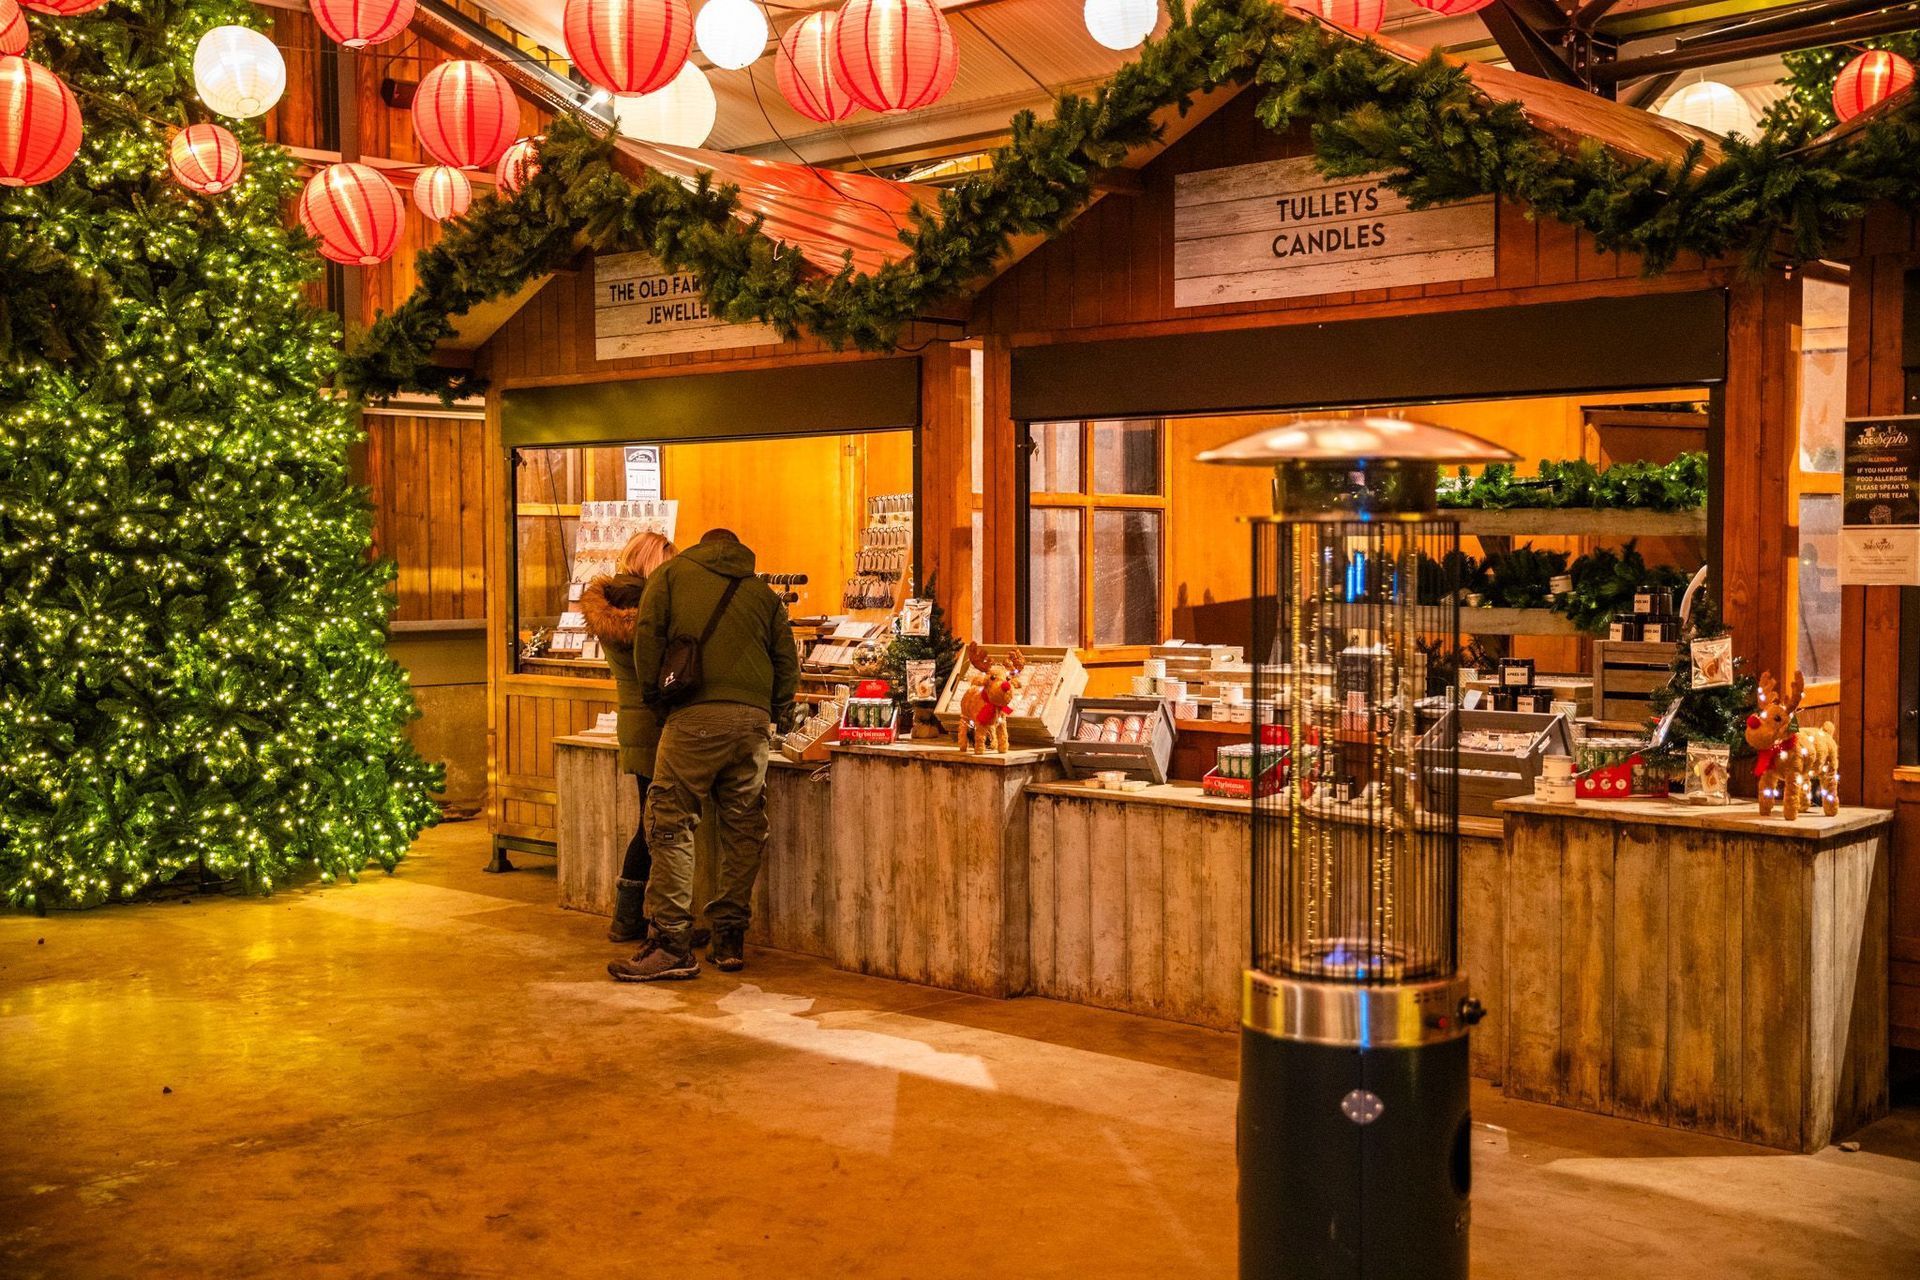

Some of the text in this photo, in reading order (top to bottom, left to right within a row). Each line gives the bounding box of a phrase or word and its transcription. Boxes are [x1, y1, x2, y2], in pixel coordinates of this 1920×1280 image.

[1277, 187, 1379, 222] TULLEYS
[1272, 223, 1386, 258] CANDLES
[609, 282, 635, 302] THE
[639, 278, 669, 299] OLD
